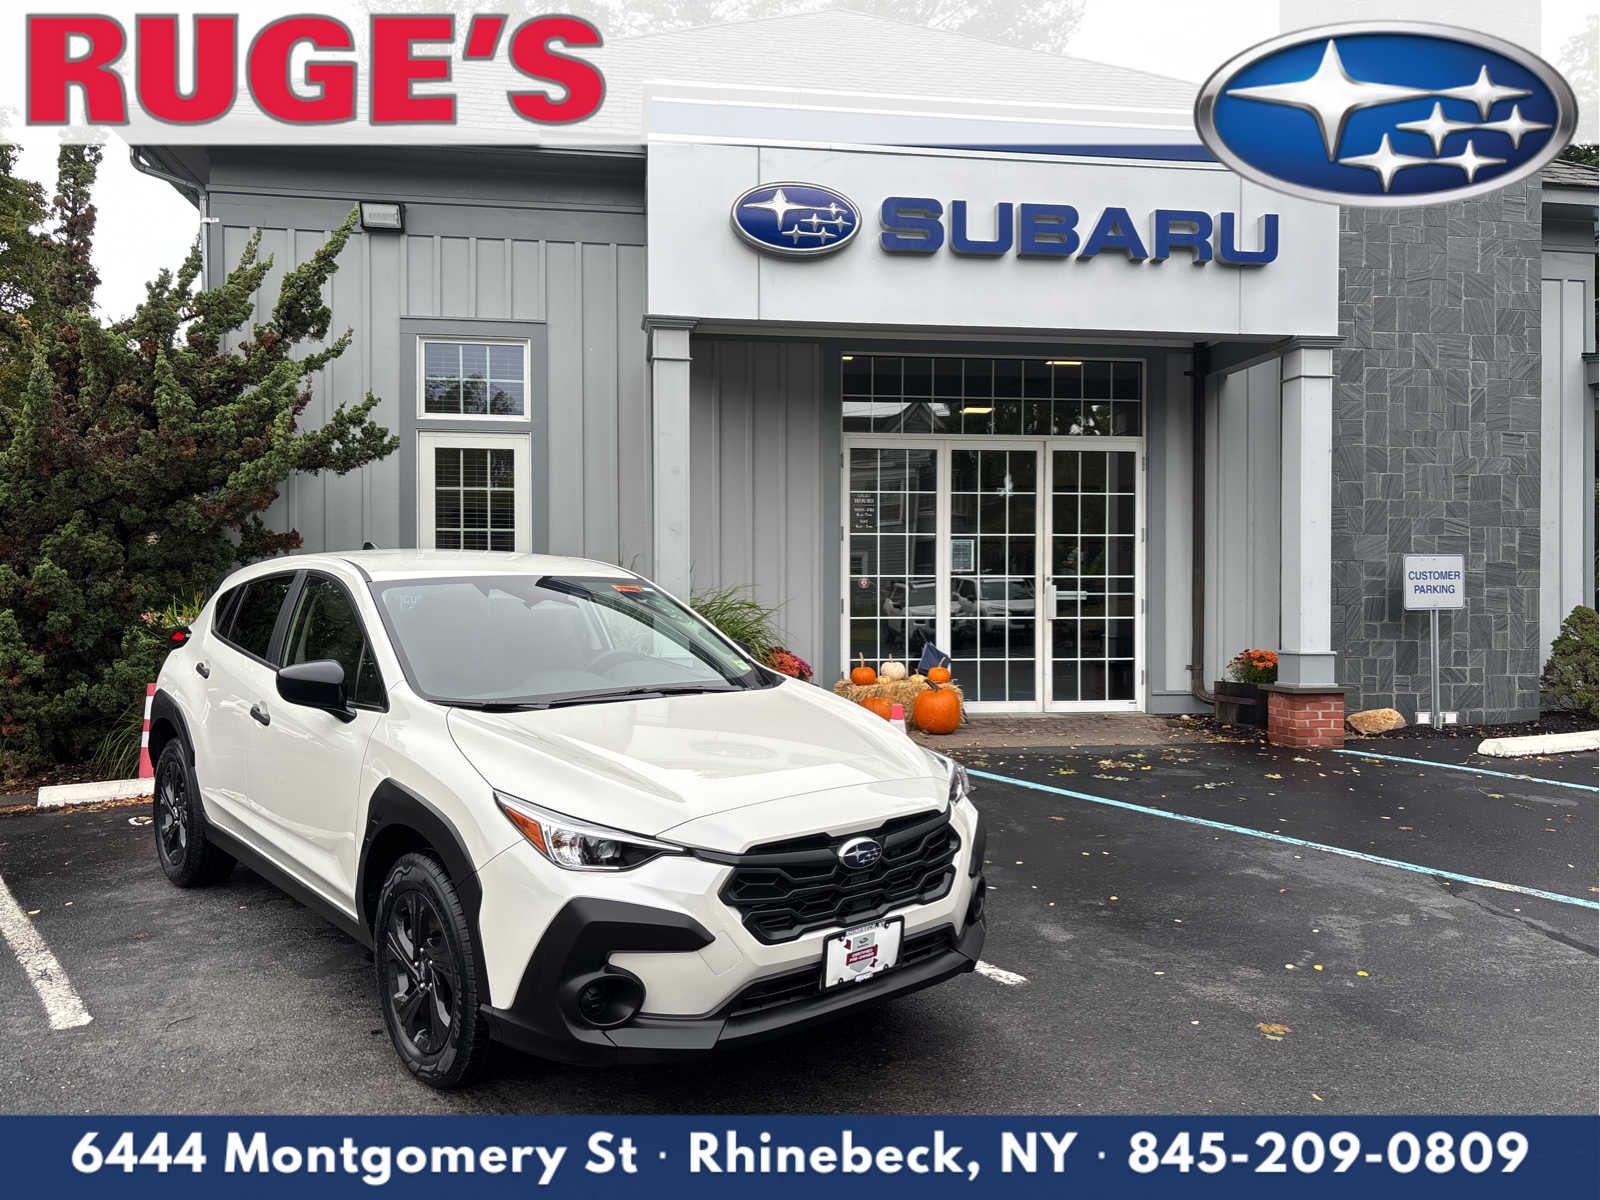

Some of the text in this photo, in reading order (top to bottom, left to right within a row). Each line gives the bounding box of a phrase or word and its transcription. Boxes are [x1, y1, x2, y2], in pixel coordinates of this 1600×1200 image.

[879, 196, 1280, 268] SUBARU
[1408, 570, 1461, 581] CUSTOMER
[1414, 584, 1456, 594] PARKING
